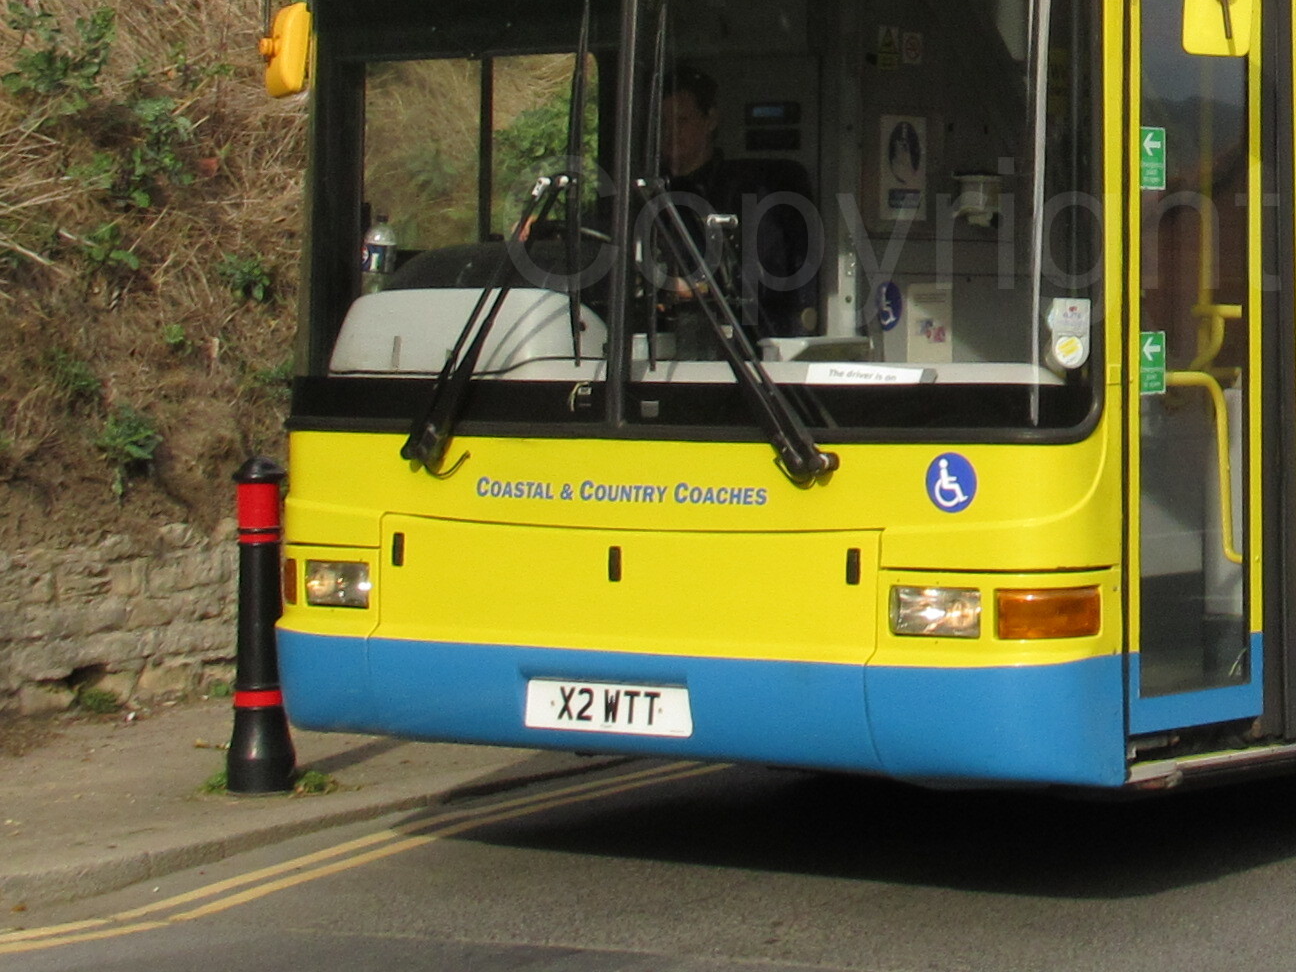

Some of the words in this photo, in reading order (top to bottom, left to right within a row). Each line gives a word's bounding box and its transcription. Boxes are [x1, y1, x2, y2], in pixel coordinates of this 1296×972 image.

[476, 476, 554, 500] COASTAL
[560, 483, 573, 500] &
[580, 480, 668, 503] COUNTRY
[673, 482, 768, 506] COACHES
[557, 686, 595, 722] X2
[604, 688, 661, 726] WTT
